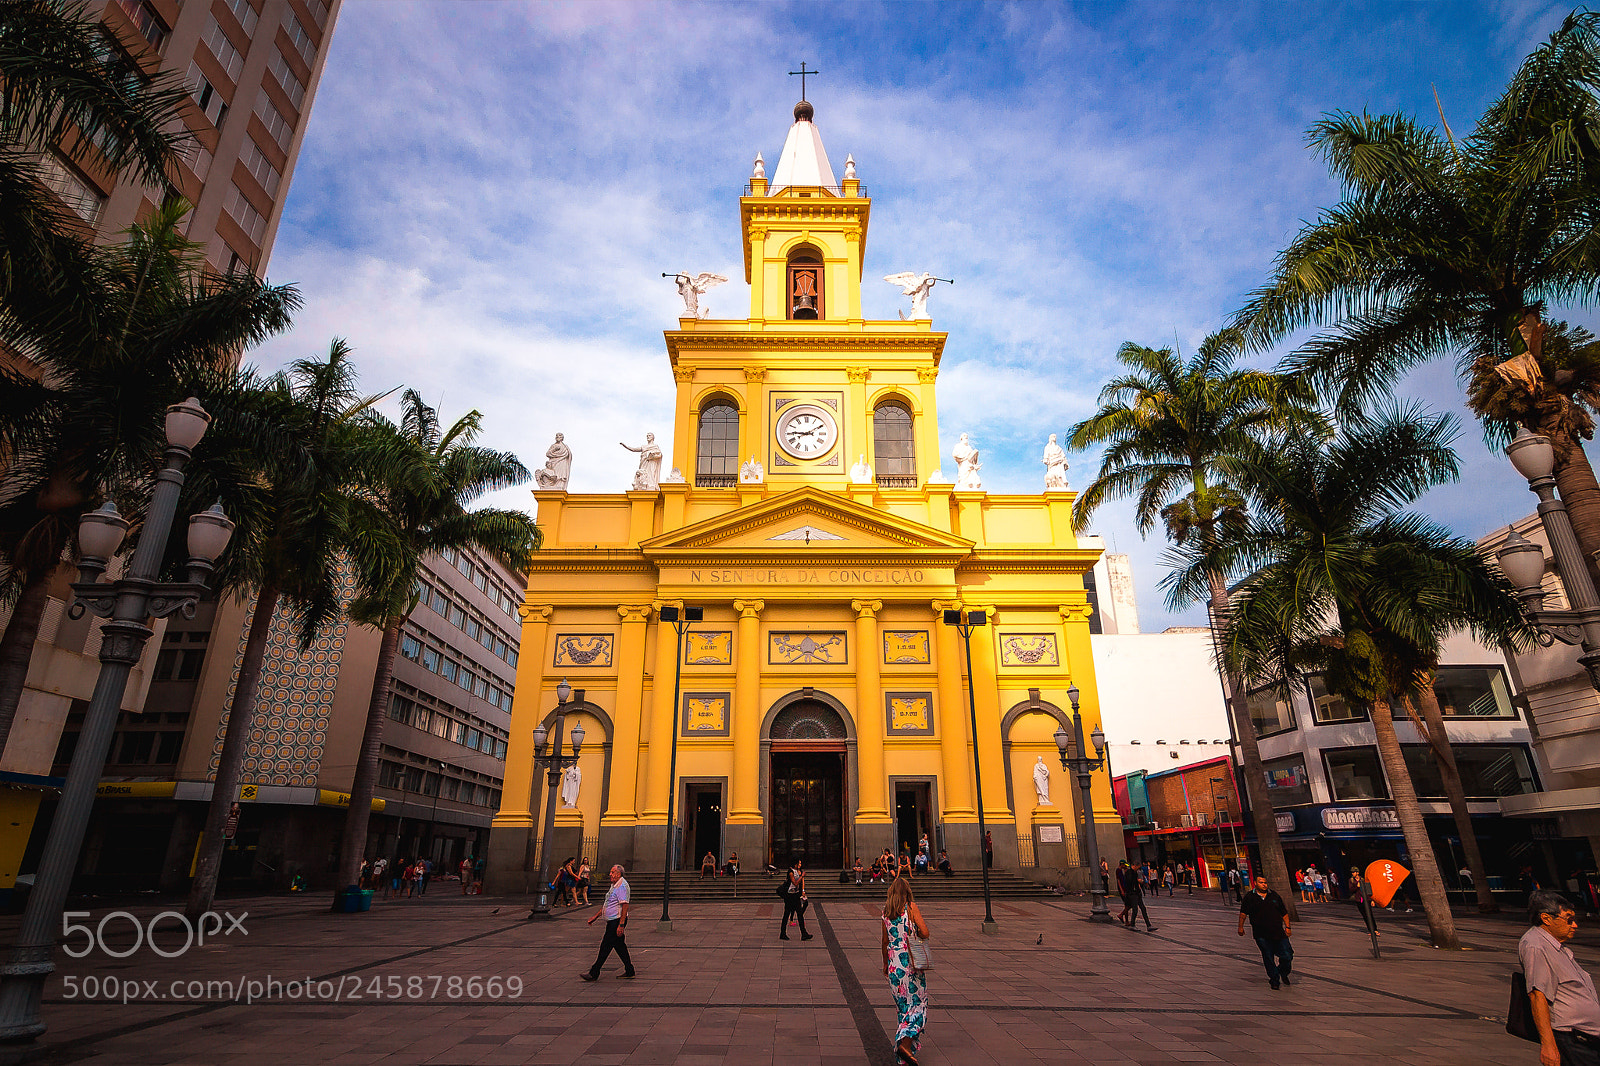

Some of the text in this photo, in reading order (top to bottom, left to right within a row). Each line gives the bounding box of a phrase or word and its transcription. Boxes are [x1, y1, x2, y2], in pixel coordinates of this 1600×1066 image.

[710, 570, 789, 583] SENHORA
[798, 570, 820, 583] DA
[828, 568, 924, 585] CONCEIÇÃO
[1326, 811, 1398, 823] MARABRAZ
[1383, 863, 1393, 883] vivo
